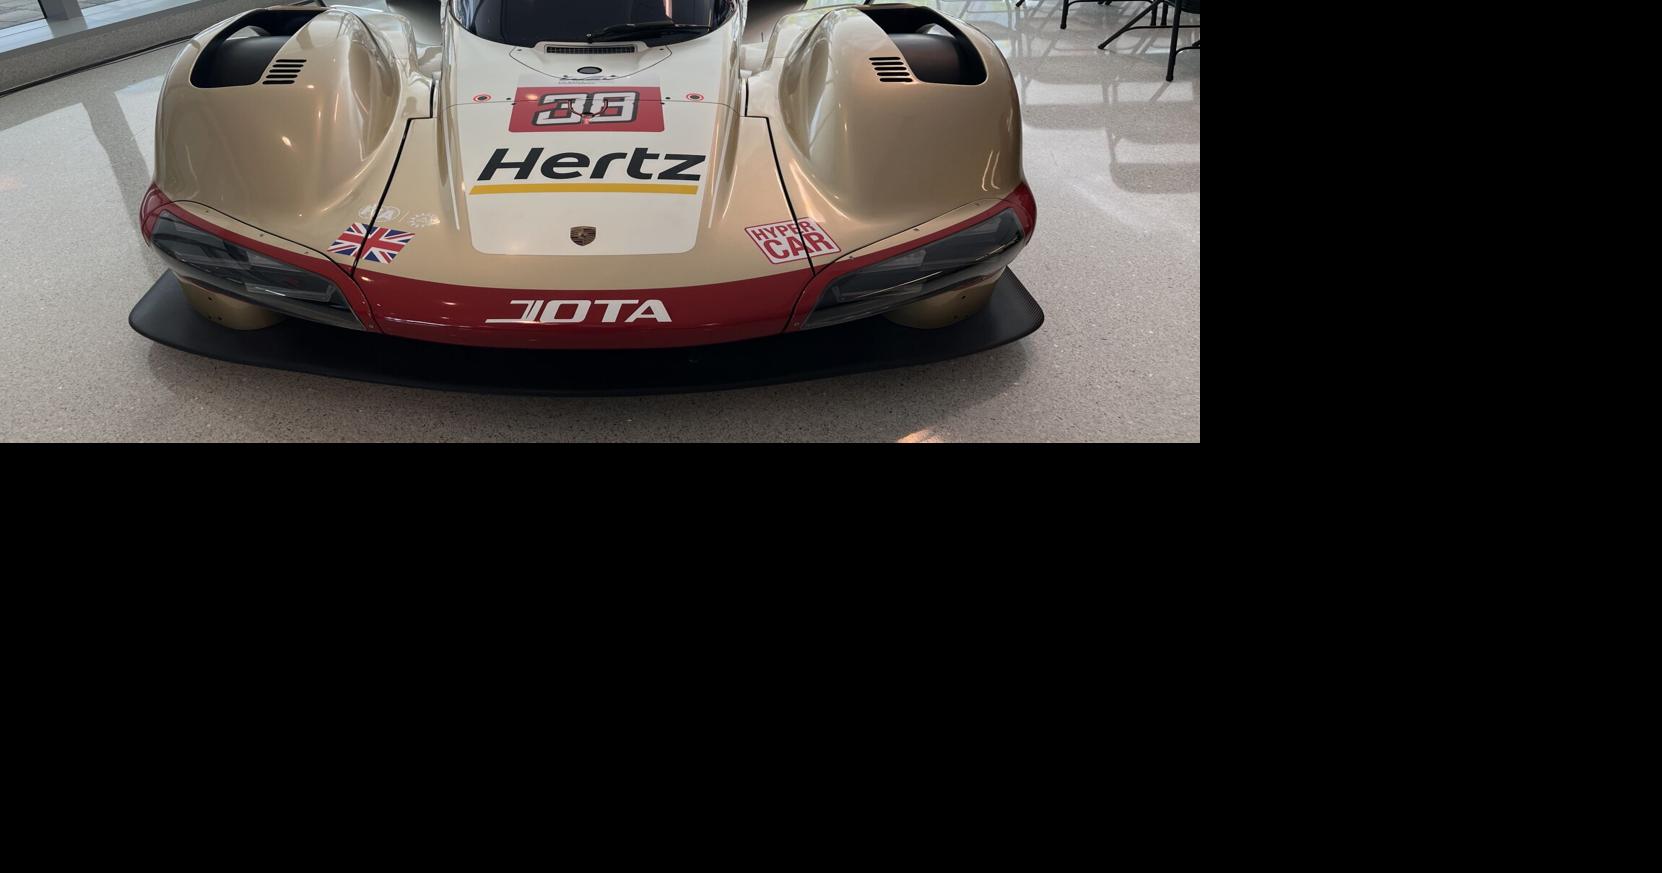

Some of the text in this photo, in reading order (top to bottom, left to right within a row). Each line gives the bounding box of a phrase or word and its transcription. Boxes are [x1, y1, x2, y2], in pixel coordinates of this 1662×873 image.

[477, 147, 706, 181] Hertz
[751, 221, 816, 241] HYPER
[763, 232, 834, 259] CAR
[485, 299, 672, 324] JOTA
